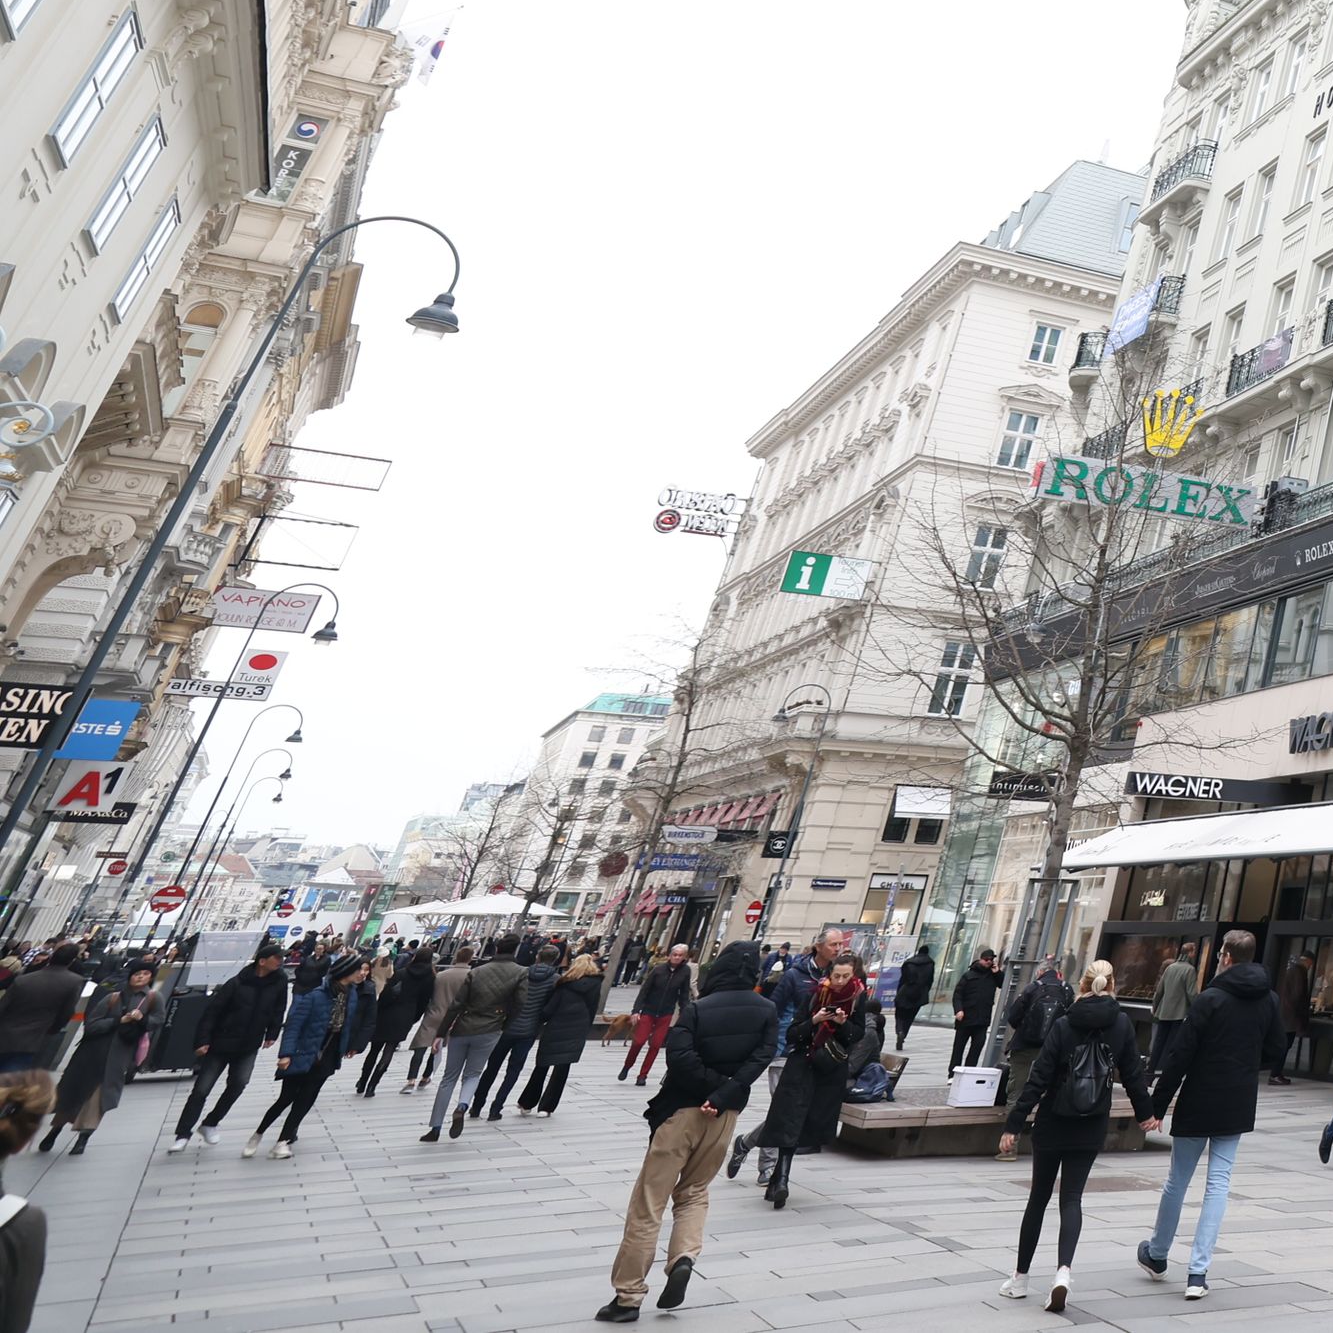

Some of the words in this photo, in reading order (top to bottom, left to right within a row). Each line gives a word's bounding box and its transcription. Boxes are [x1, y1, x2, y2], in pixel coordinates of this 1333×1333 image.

[270, 150, 300, 196] KOREA
[1044, 457, 1252, 526] ROLEX
[221, 595, 306, 608] VAPIANO
[239, 672, 272, 683] Turek
[0, 687, 73, 715] SIN
[71, 723, 105, 735] RSTE
[57, 767, 124, 807] A1
[1135, 773, 1223, 799] WAGNER
